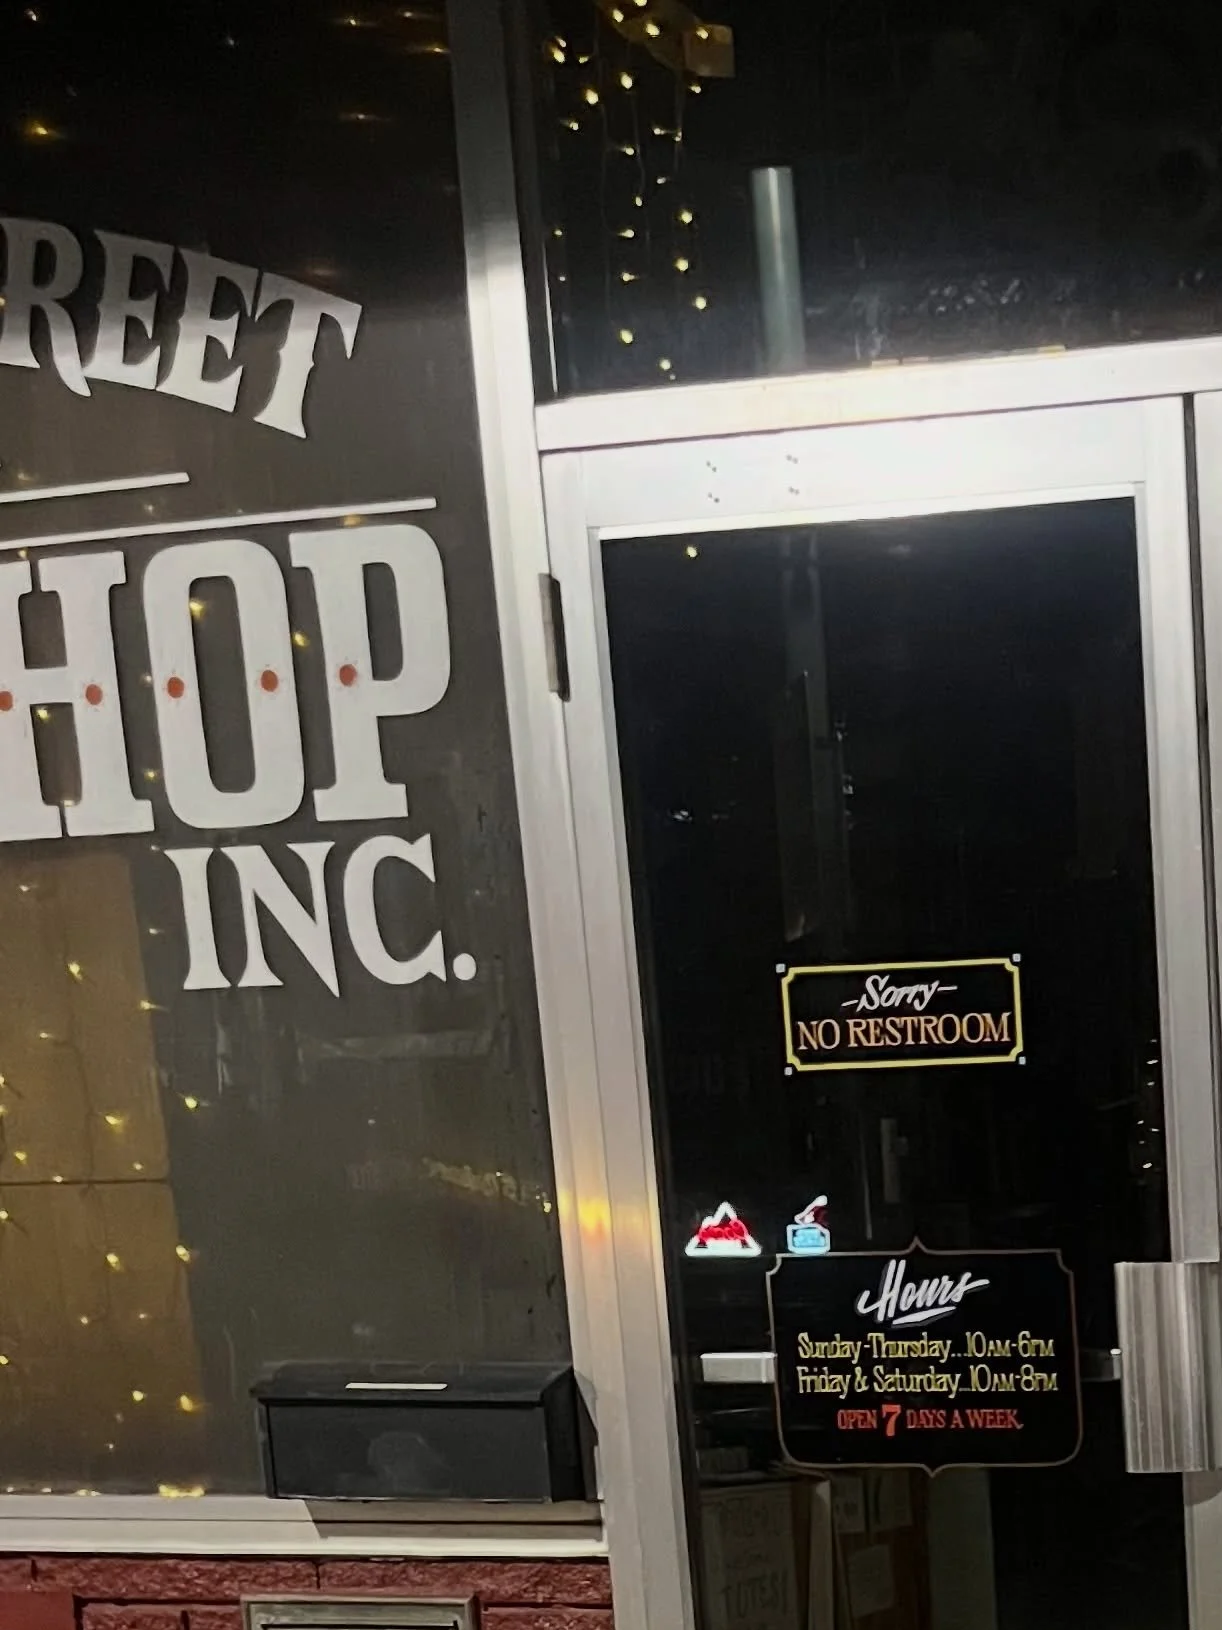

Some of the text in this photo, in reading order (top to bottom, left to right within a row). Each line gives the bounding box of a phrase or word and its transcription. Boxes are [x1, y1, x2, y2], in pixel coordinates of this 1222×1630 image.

[0, 522, 451, 842] HOP
[163, 833, 477, 998] INC.
[797, 1011, 1012, 1050] NO RESTROOM
[856, 1258, 990, 1324] Hours
[796, 1366, 851, 1399] Friday
[854, 1366, 869, 1392] &
[837, 1409, 877, 1429] OPEN
[881, 1403, 902, 1437] 7
[906, 1408, 946, 1429] DAYS
[950, 1408, 964, 1429] A
